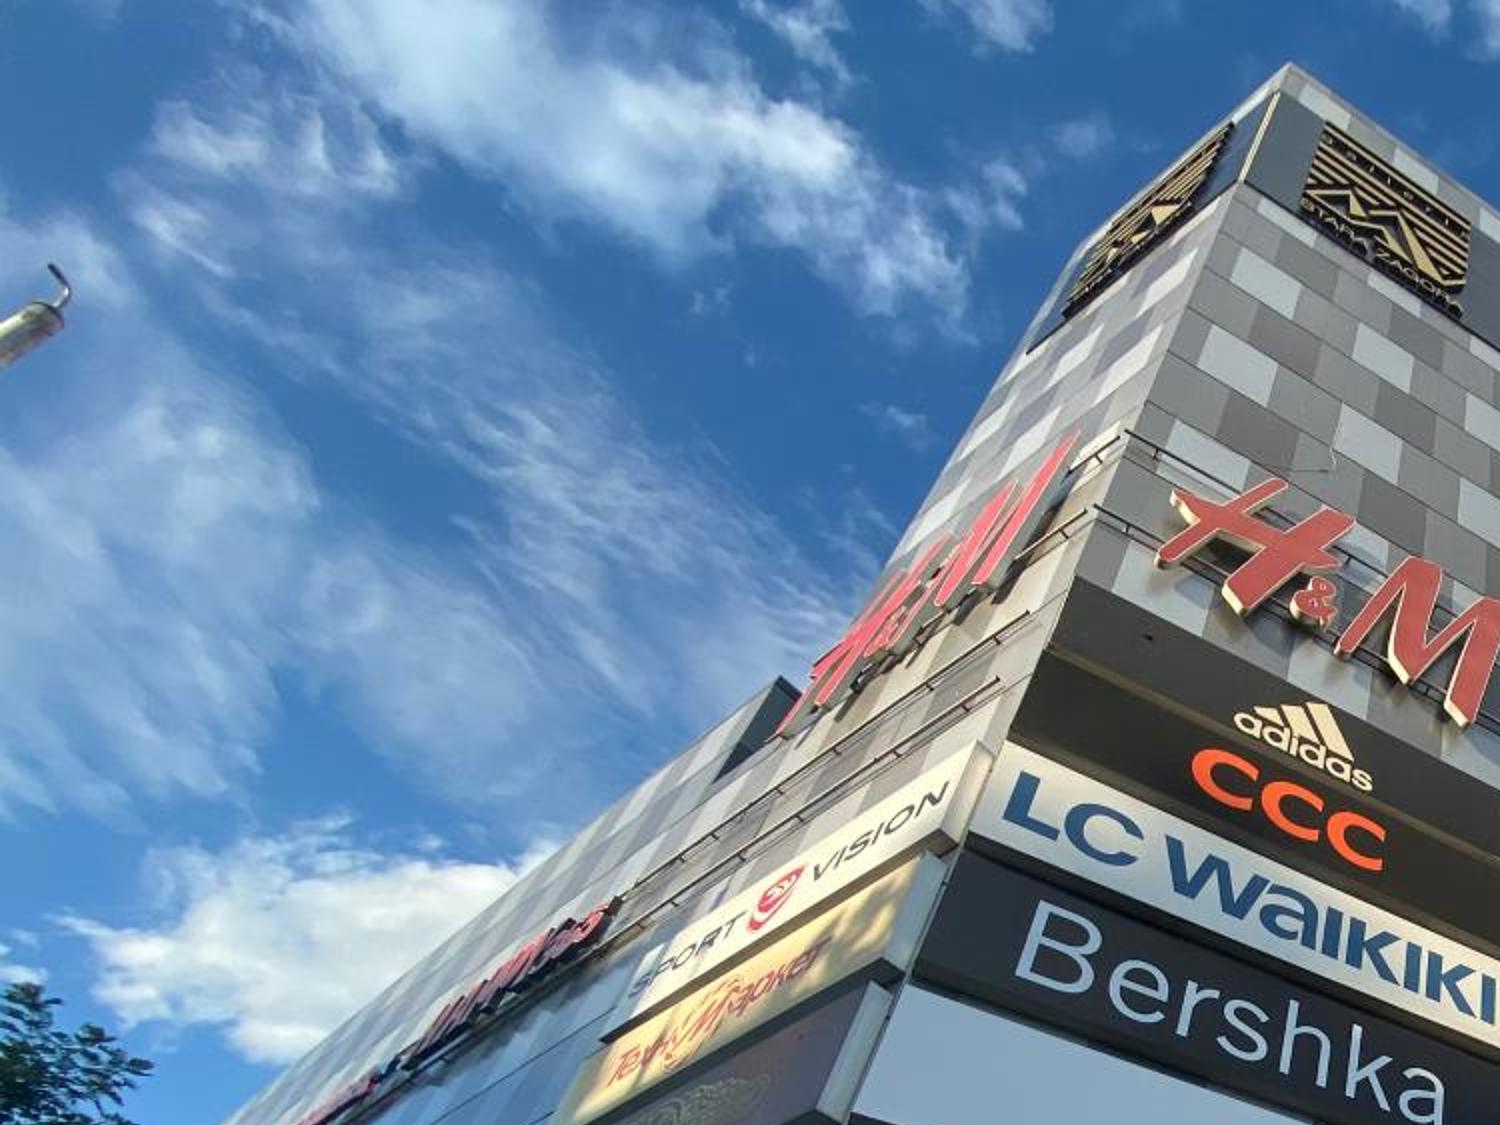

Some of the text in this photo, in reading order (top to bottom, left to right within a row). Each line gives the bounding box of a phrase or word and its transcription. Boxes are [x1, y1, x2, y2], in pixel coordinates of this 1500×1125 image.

[1232, 711, 1374, 792] adidas
[1002, 770, 1145, 866] LC
[1190, 748, 1387, 872] CCC
[627, 911, 747, 1000] SPORT
[812, 781, 950, 882] VISION
